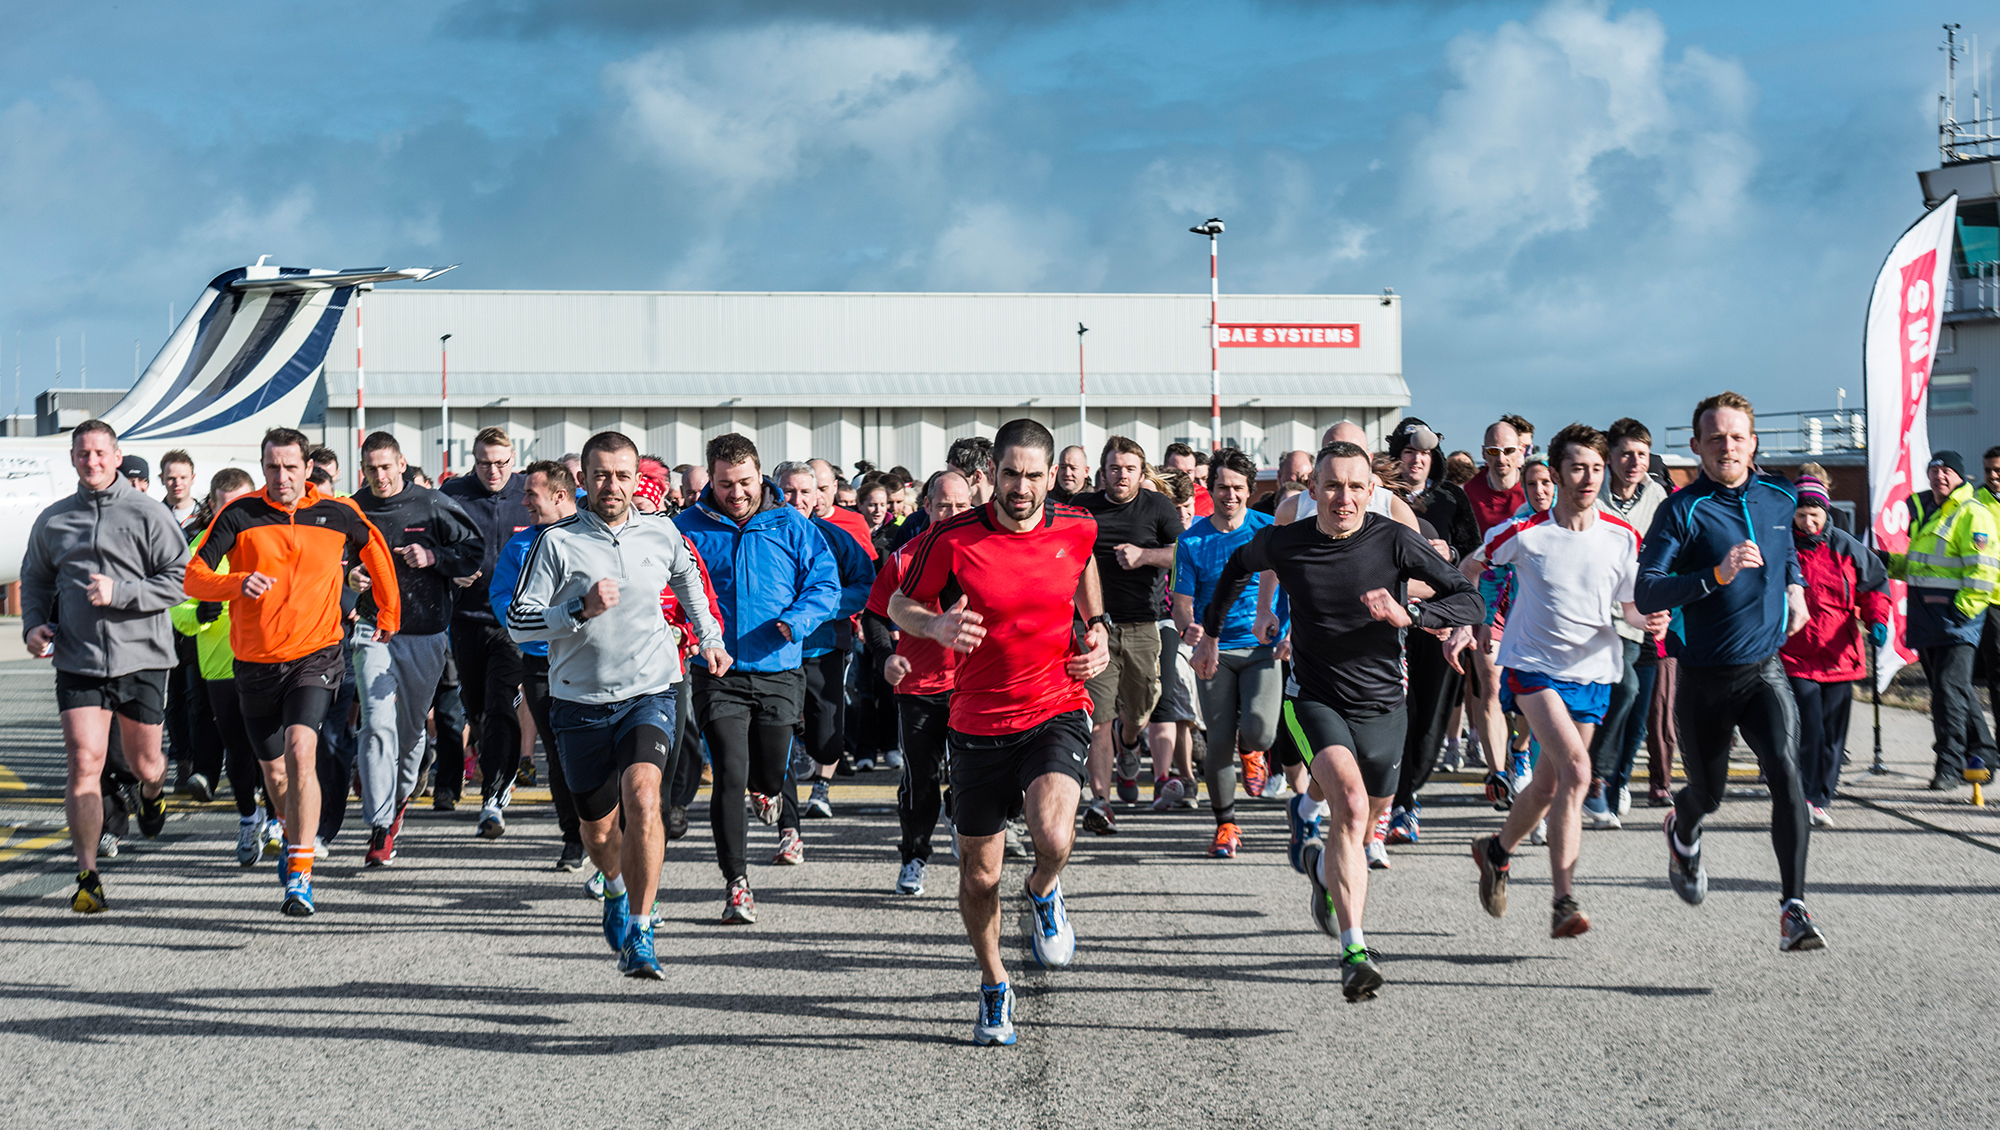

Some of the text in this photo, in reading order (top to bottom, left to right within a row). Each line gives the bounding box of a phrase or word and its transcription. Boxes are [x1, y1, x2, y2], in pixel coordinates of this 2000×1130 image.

[1219, 328, 1354, 343] BAE SYSTEMS
[436, 438, 541, 468] THK
